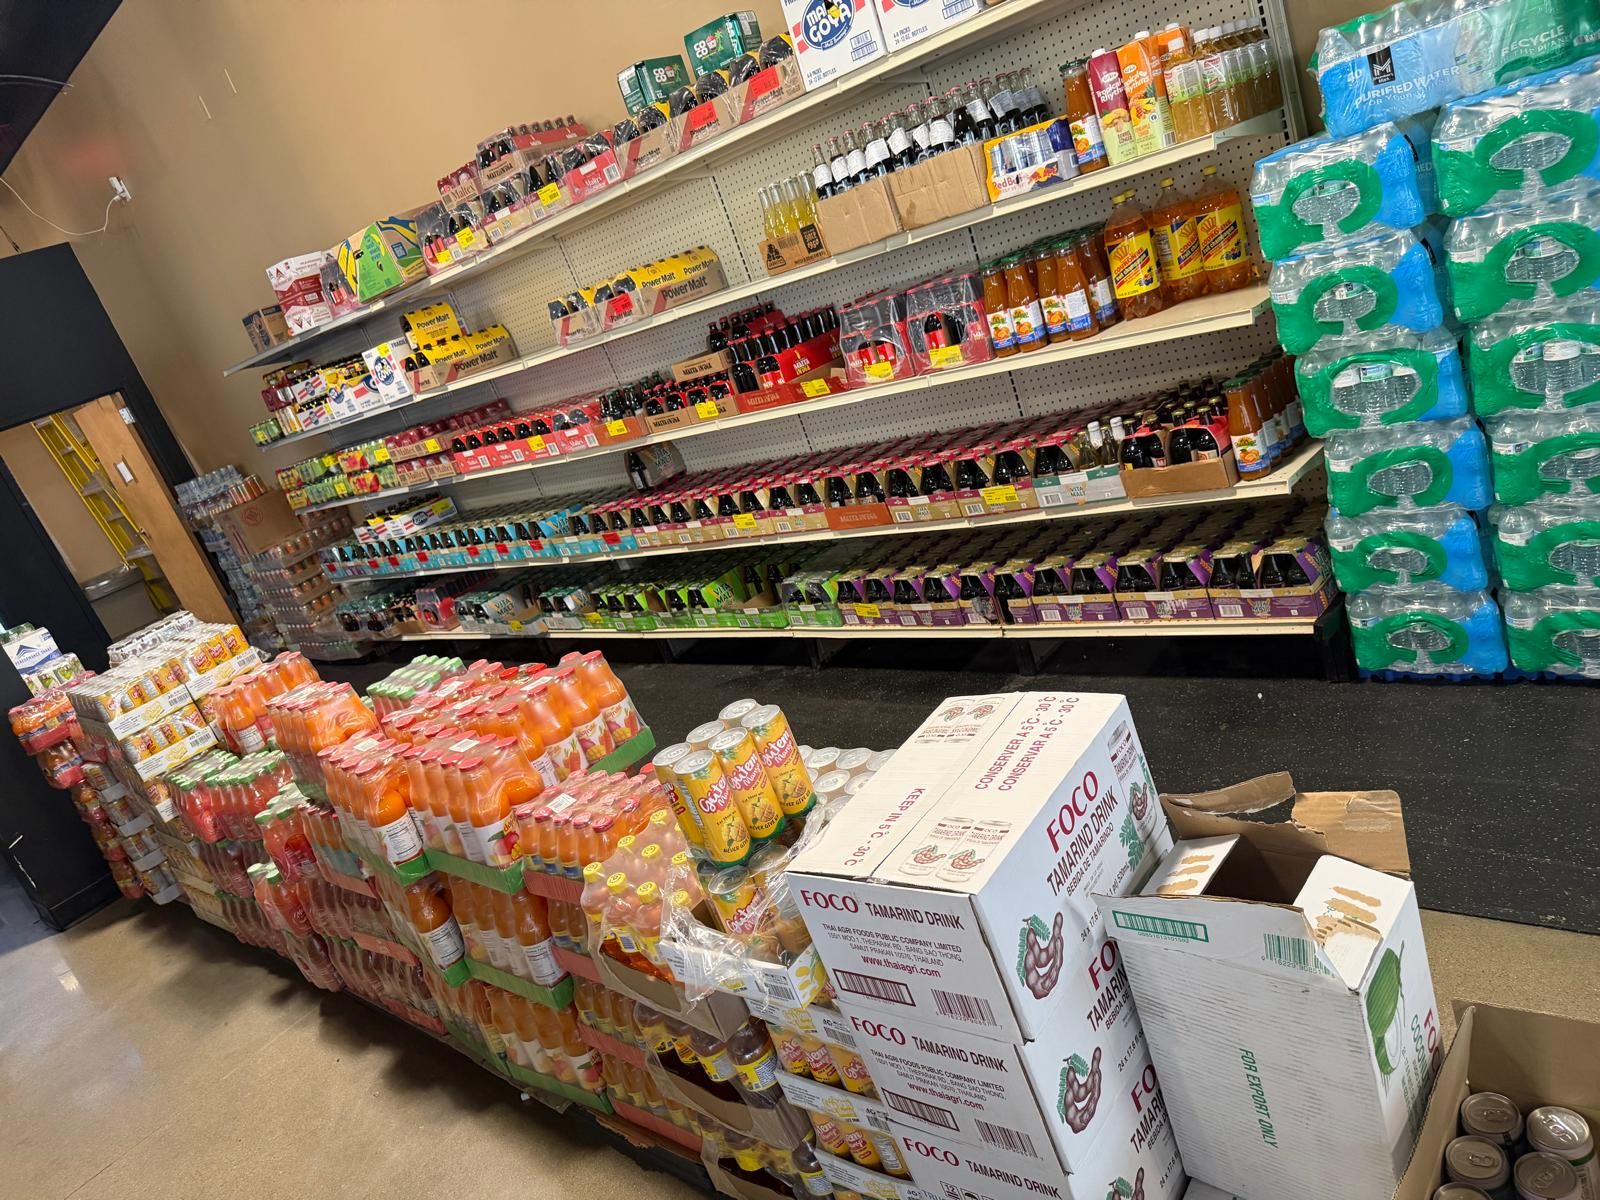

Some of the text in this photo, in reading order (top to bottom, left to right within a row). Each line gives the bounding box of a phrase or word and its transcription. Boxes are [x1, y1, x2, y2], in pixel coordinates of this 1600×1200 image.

[1355, 65, 1460, 108] PURIFIED WATER
[993, 176, 1006, 190] Red
[642, 272, 675, 288] Power Malt
[683, 264, 701, 275] Power
[662, 276, 708, 300] Power Malt
[416, 313, 450, 329] Power Malt
[435, 349, 467, 364] Power Malt
[475, 340, 493, 350] Power
[454, 350, 498, 373] Power Malt
[975, 738, 1024, 790] CONSERVER
[998, 740, 1048, 791] CONSERVAR
[898, 788, 926, 811] KEEP
[1046, 770, 1098, 853] FOCO
[884, 812, 903, 822] IN
[1046, 821, 1093, 896] TAMARIND
[1090, 785, 1118, 836] DRINK
[1066, 869, 1085, 896] BEBIDA
[1082, 856, 1091, 874] DE
[1090, 822, 1114, 862] TAMARINDO
[800, 889, 964, 930] FOCO TAMARIND DRINK
[822, 923, 962, 953] THAI AGRI FOODS PUBLIC COMPANY LIMITED
[861, 954, 941, 978] www.thaiagri.com
[914, 954, 943, 966] THAILAND
[1088, 940, 1118, 991] FO
[1087, 961, 1128, 1032] TAMARIN
[1105, 1001, 1124, 1030] BEBIDA
[850, 1016, 906, 1046] FOCO
[911, 1036, 968, 1062] TAMARIND
[970, 1052, 1008, 1072] DRINK
[1424, 1007, 1440, 1073] FOC
[977, 1079, 1005, 1092] LIMITED
[1131, 1063, 1157, 1113] FO
[1238, 1048, 1279, 1149] FOR EXPORT ONLY
[902, 1137, 1062, 1199] FOCO TAMARIND DRINK
